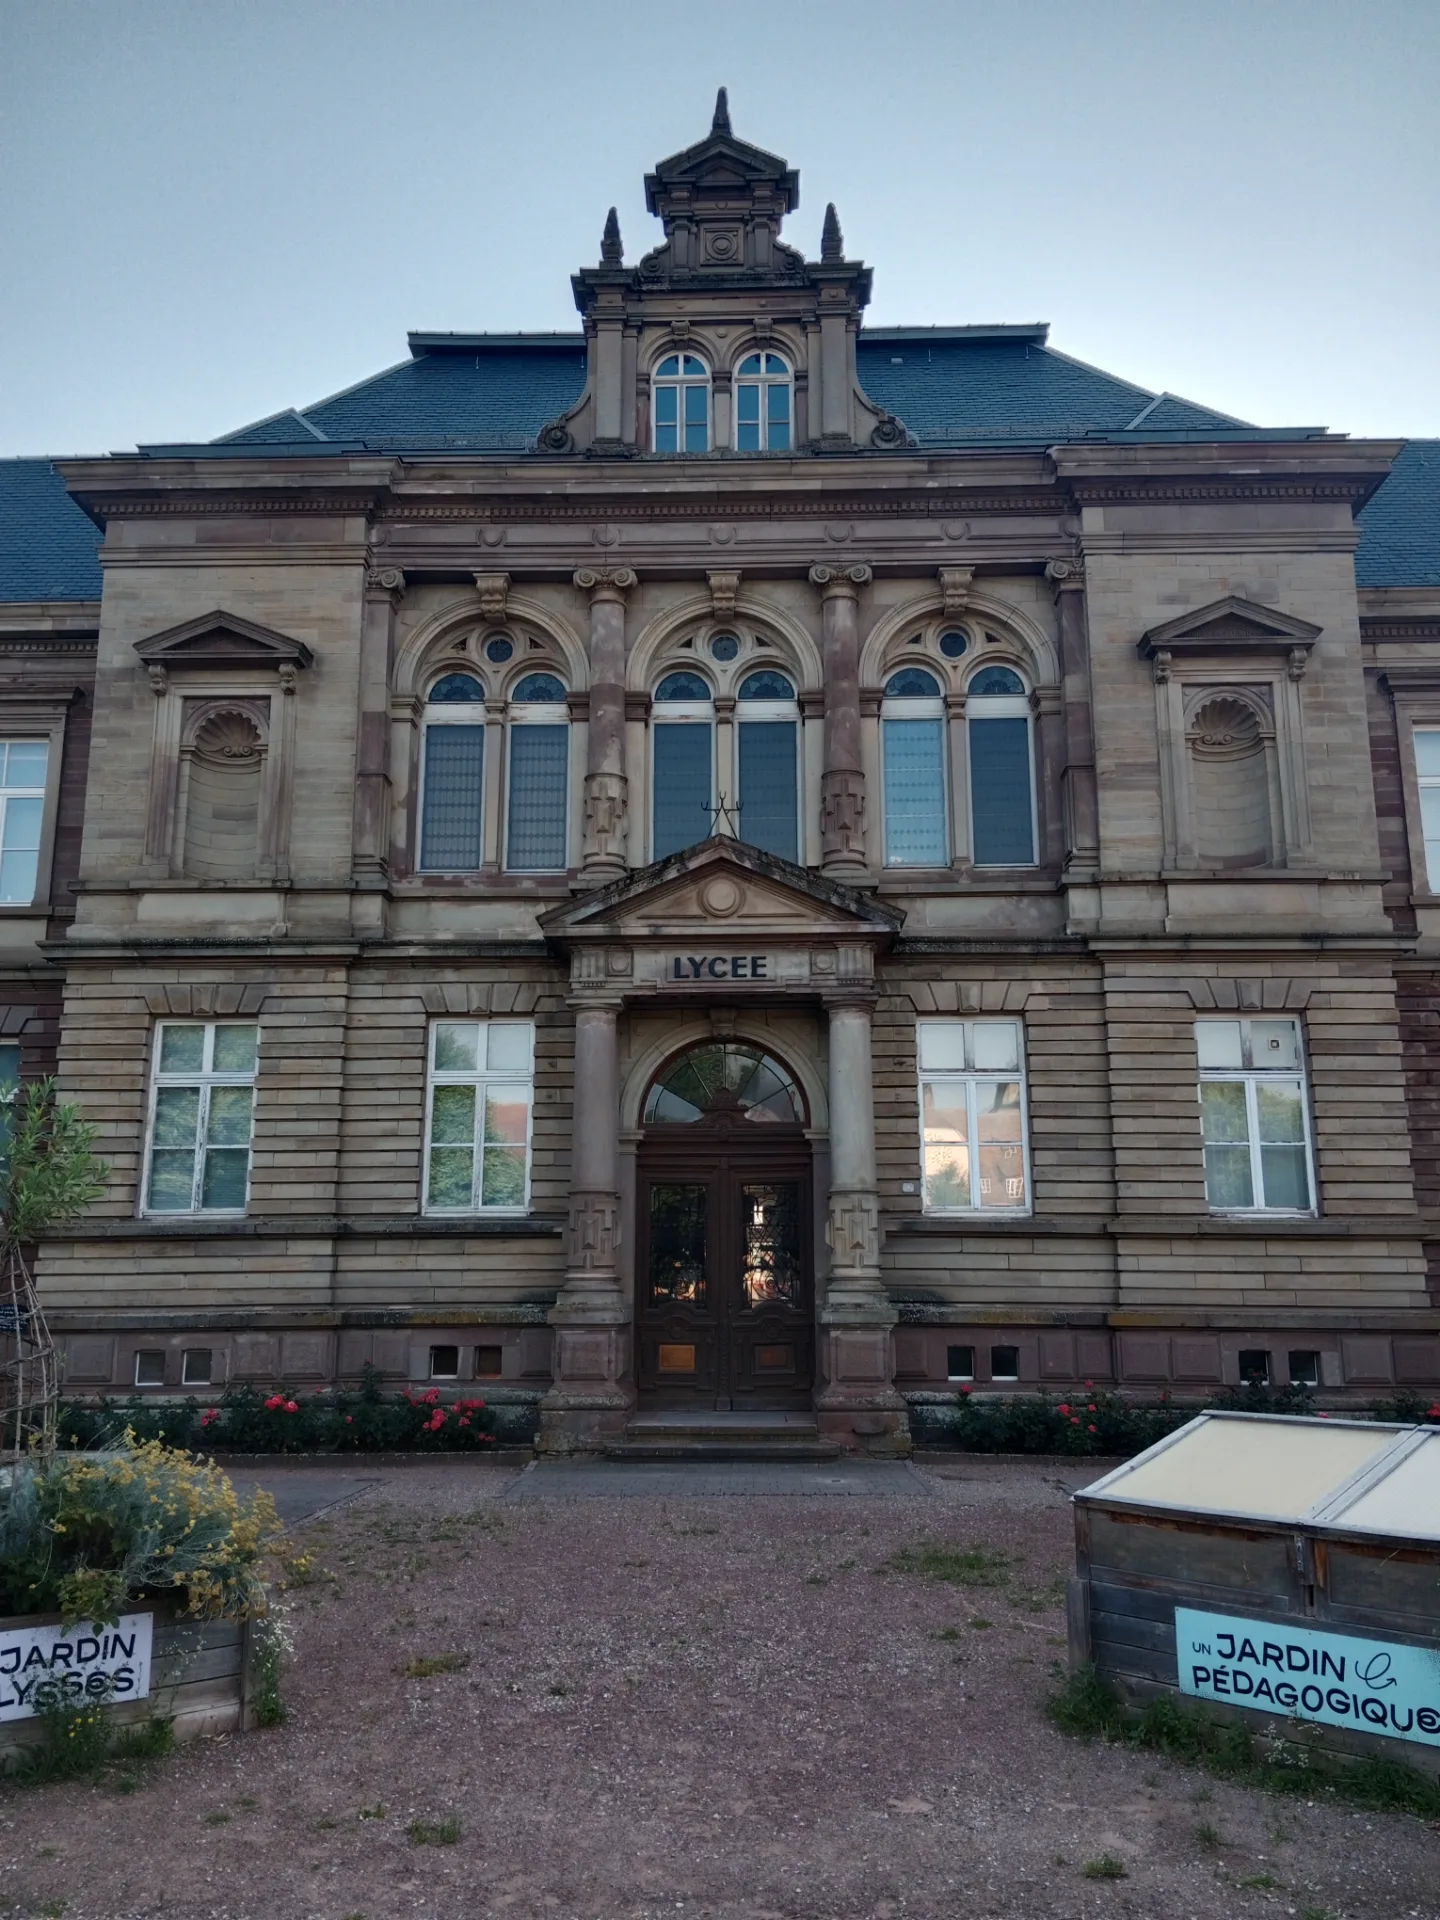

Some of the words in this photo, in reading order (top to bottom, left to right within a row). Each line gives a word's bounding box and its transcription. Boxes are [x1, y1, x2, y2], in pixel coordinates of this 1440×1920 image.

[674, 956, 767, 979] LYCEE
[0, 1634, 136, 1675] JARDIN
[1192, 1641, 1211, 1656] UN
[1216, 1633, 1346, 1682] JARDIN
